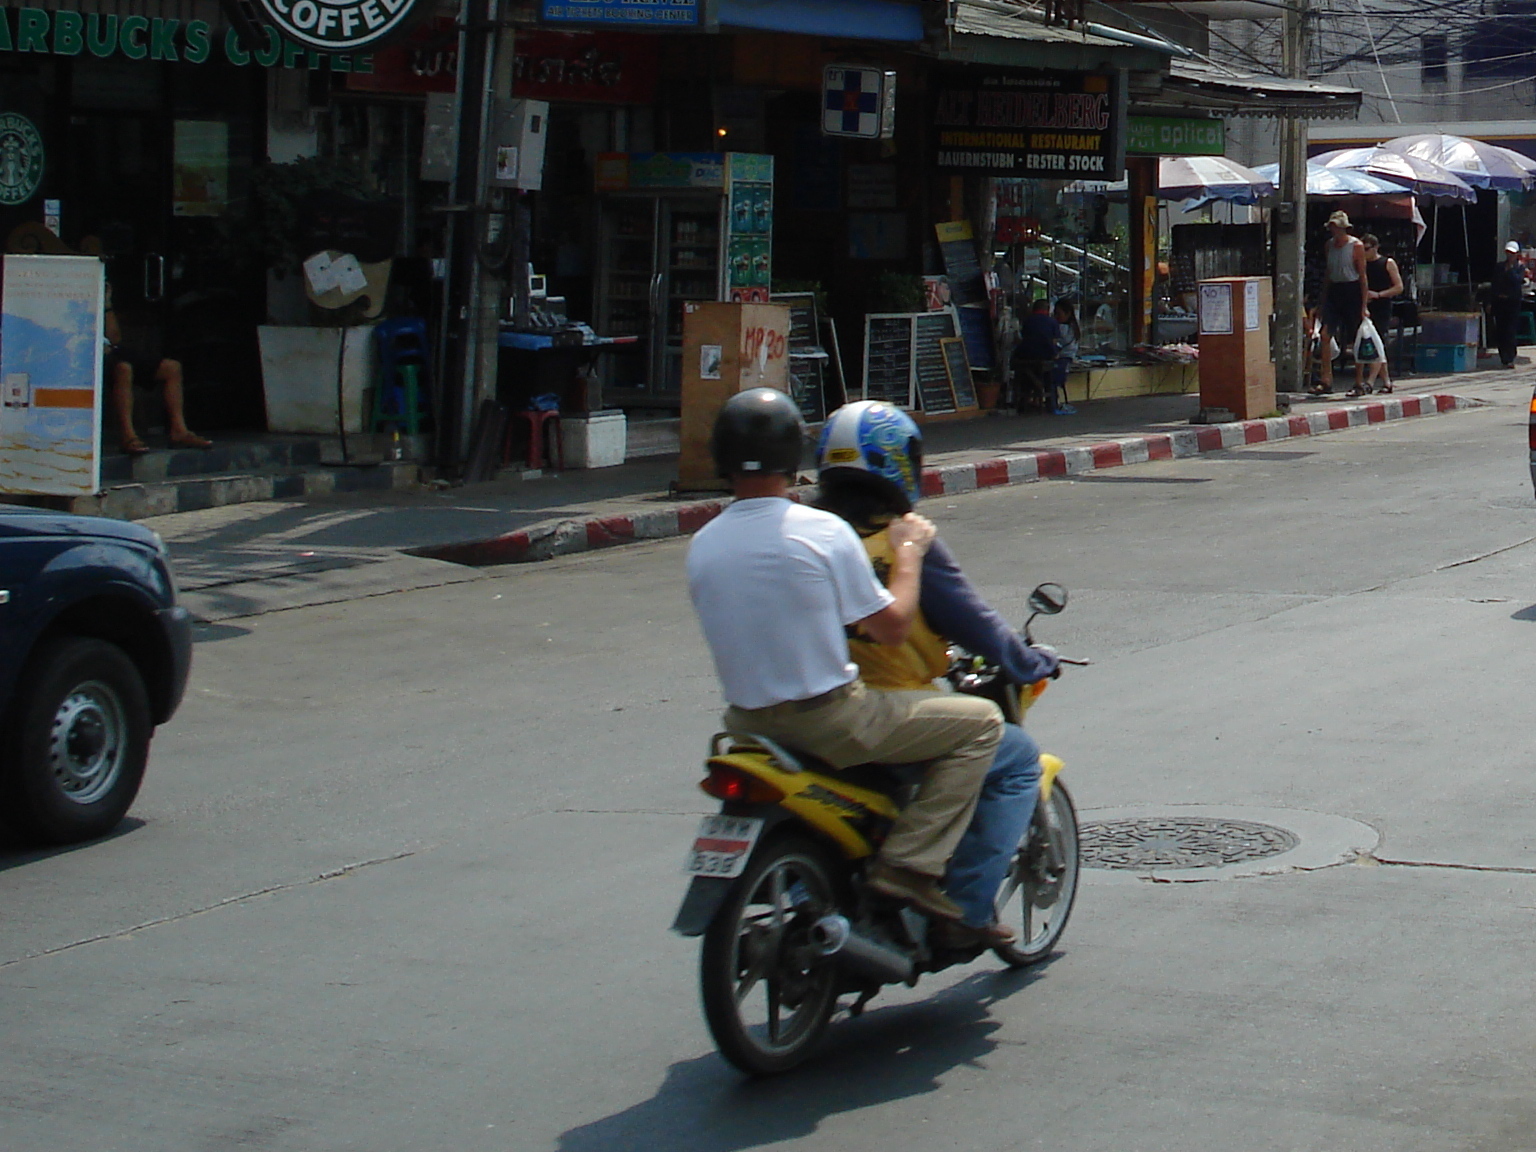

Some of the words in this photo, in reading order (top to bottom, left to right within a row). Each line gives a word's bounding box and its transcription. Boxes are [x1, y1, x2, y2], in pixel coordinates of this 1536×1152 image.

[547, 6, 563, 18] AIR
[604, 7, 653, 20] BOOKING
[655, 9, 695, 22] CENTER
[933, 90, 974, 126] ALT
[975, 91, 1111, 131] HEIDELBERG
[940, 131, 1025, 149] INTERNATIONAL
[1030, 133, 1103, 151] RESTAURANT
[1160, 121, 1223, 149] optical
[937, 151, 1015, 169] BAUERNSTUBN
[1026, 154, 1066, 171] ERSTER
[1069, 155, 1105, 172] STOCK
